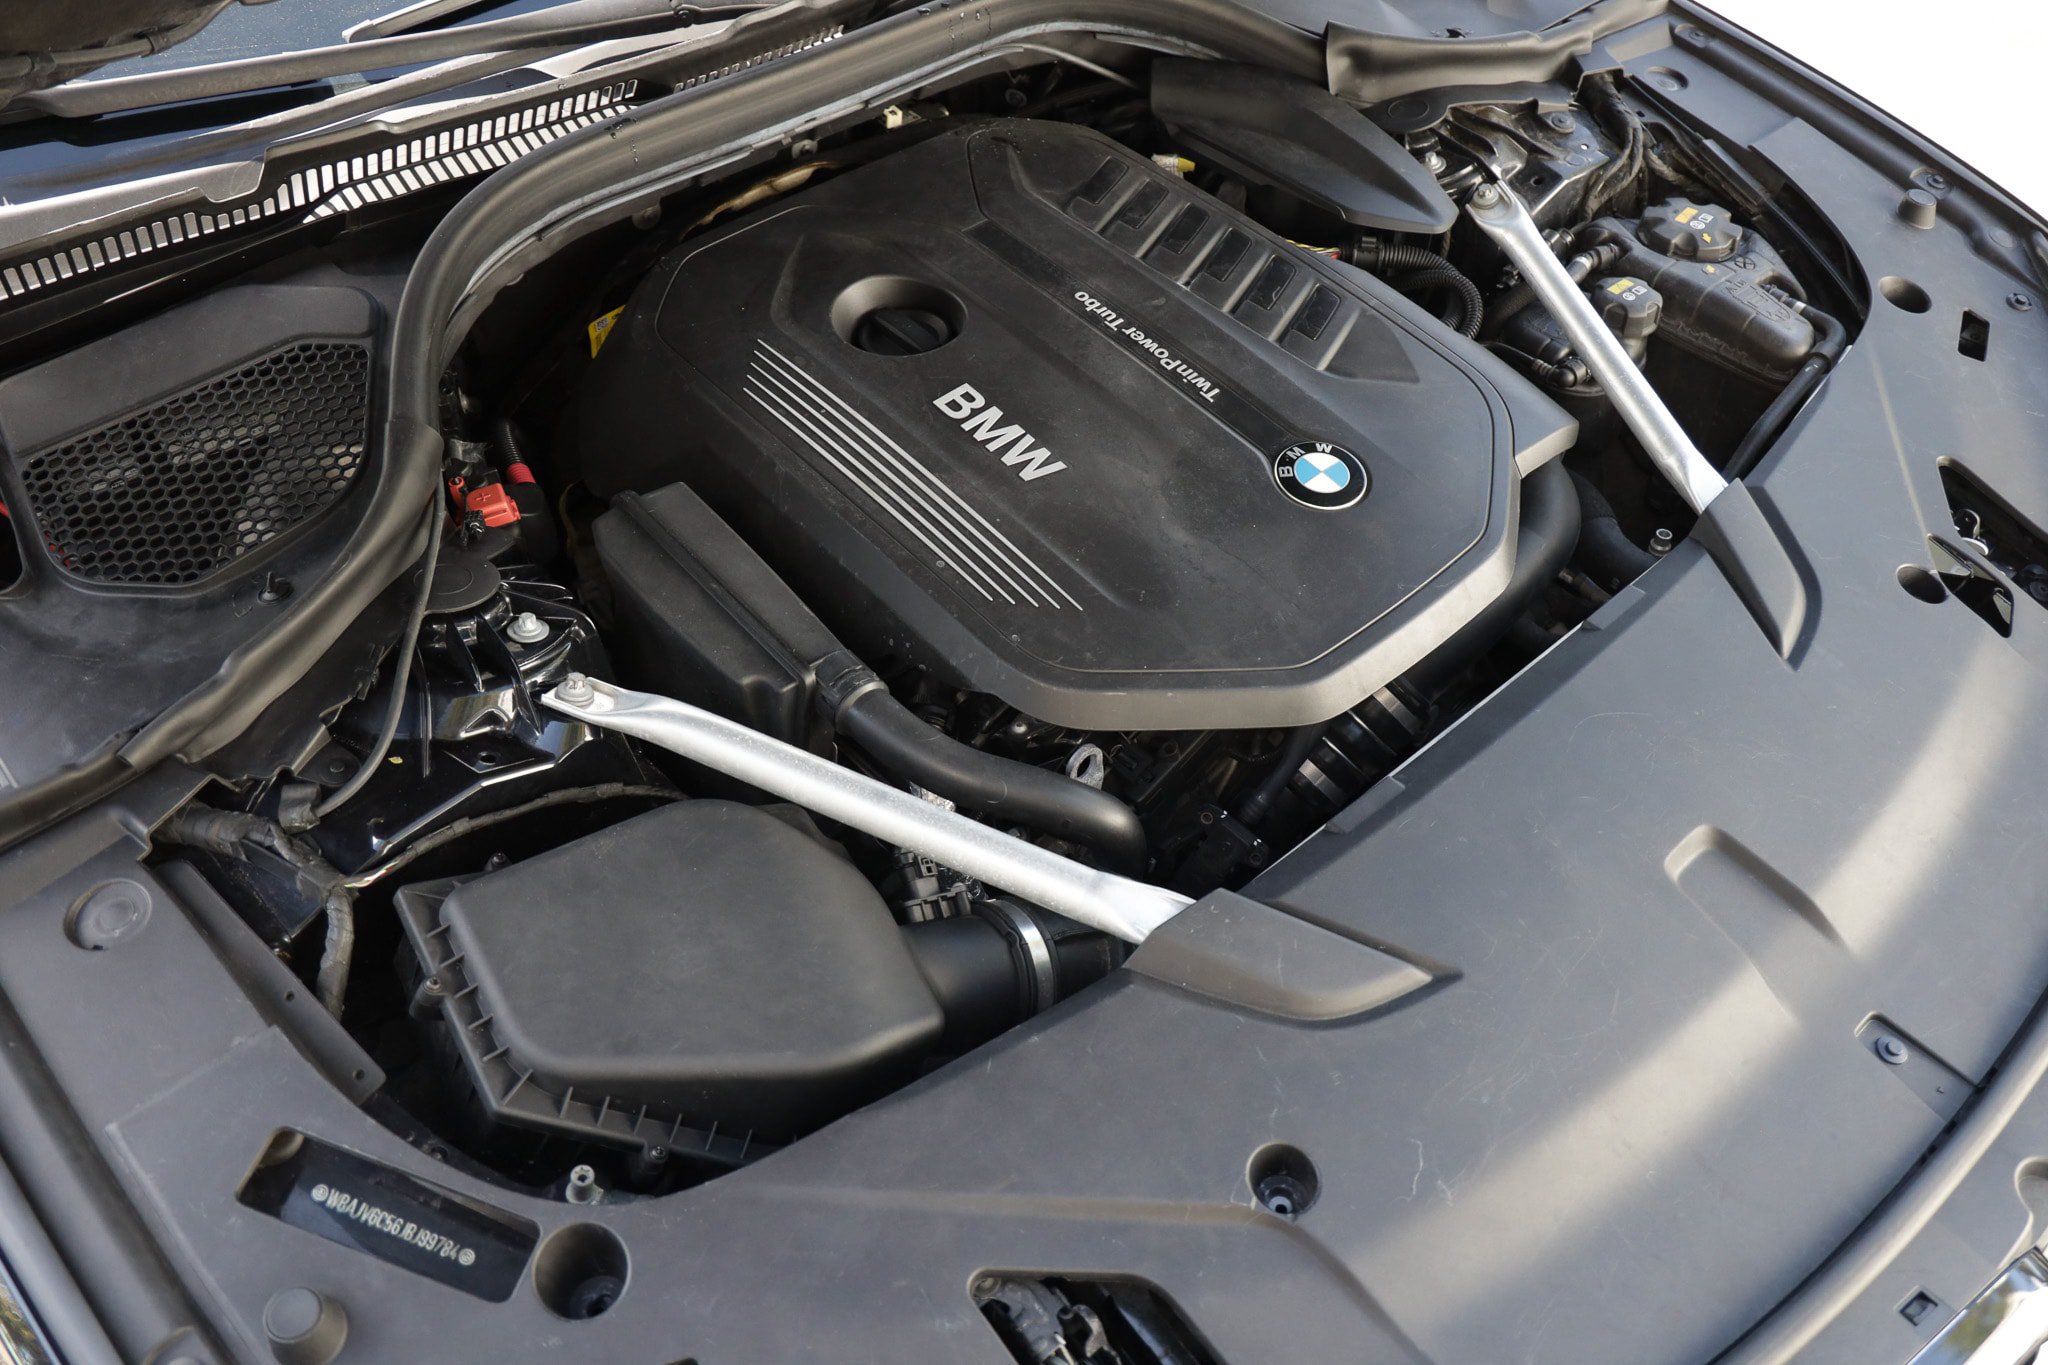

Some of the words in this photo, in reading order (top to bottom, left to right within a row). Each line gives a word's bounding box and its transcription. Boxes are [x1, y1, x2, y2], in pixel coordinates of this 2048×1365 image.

[1074, 290, 1126, 332] Turbo
[1121, 326, 1220, 403] TwinPower
[932, 382, 1068, 482] BMW
[1278, 442, 1333, 478] BMW
